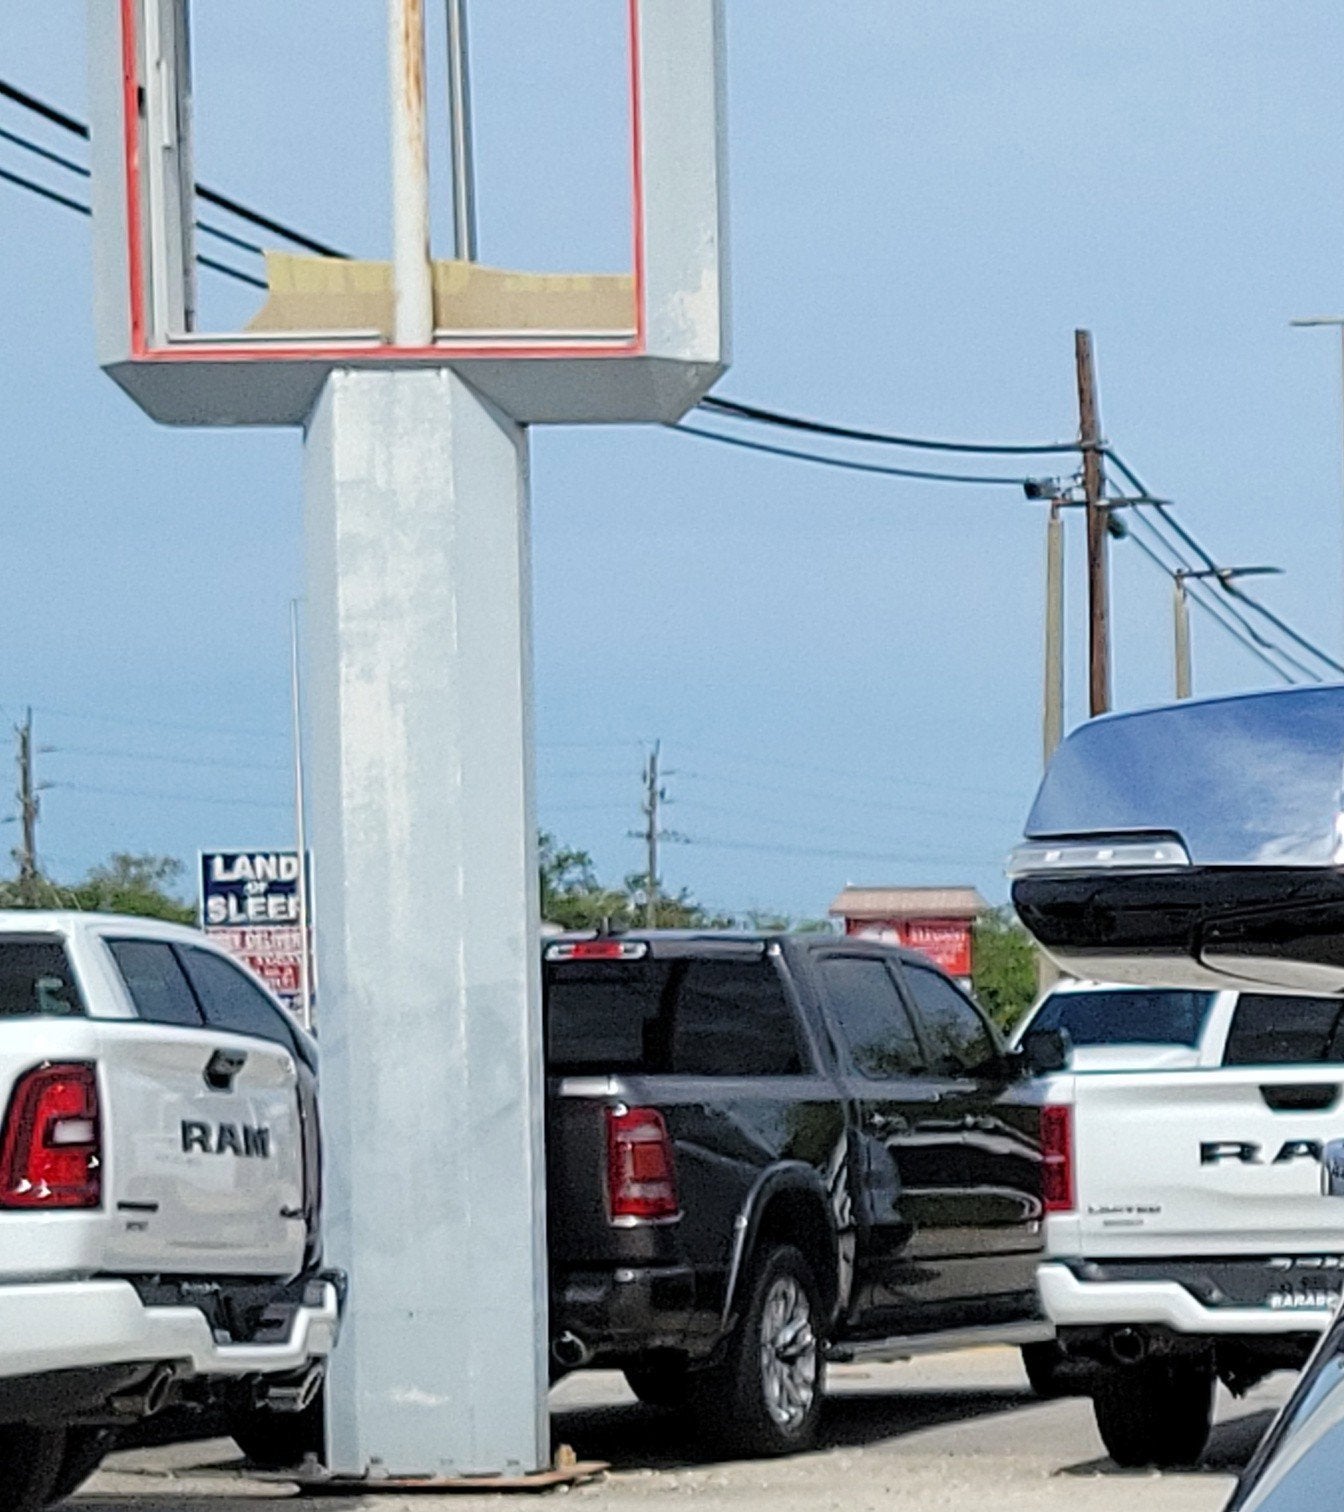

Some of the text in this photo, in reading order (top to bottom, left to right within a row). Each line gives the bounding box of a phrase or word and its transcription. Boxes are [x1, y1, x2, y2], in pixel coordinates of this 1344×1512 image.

[213, 855, 298, 881] LAND
[181, 1119, 270, 1160] RAM
[1199, 1141, 1324, 1165] RA
